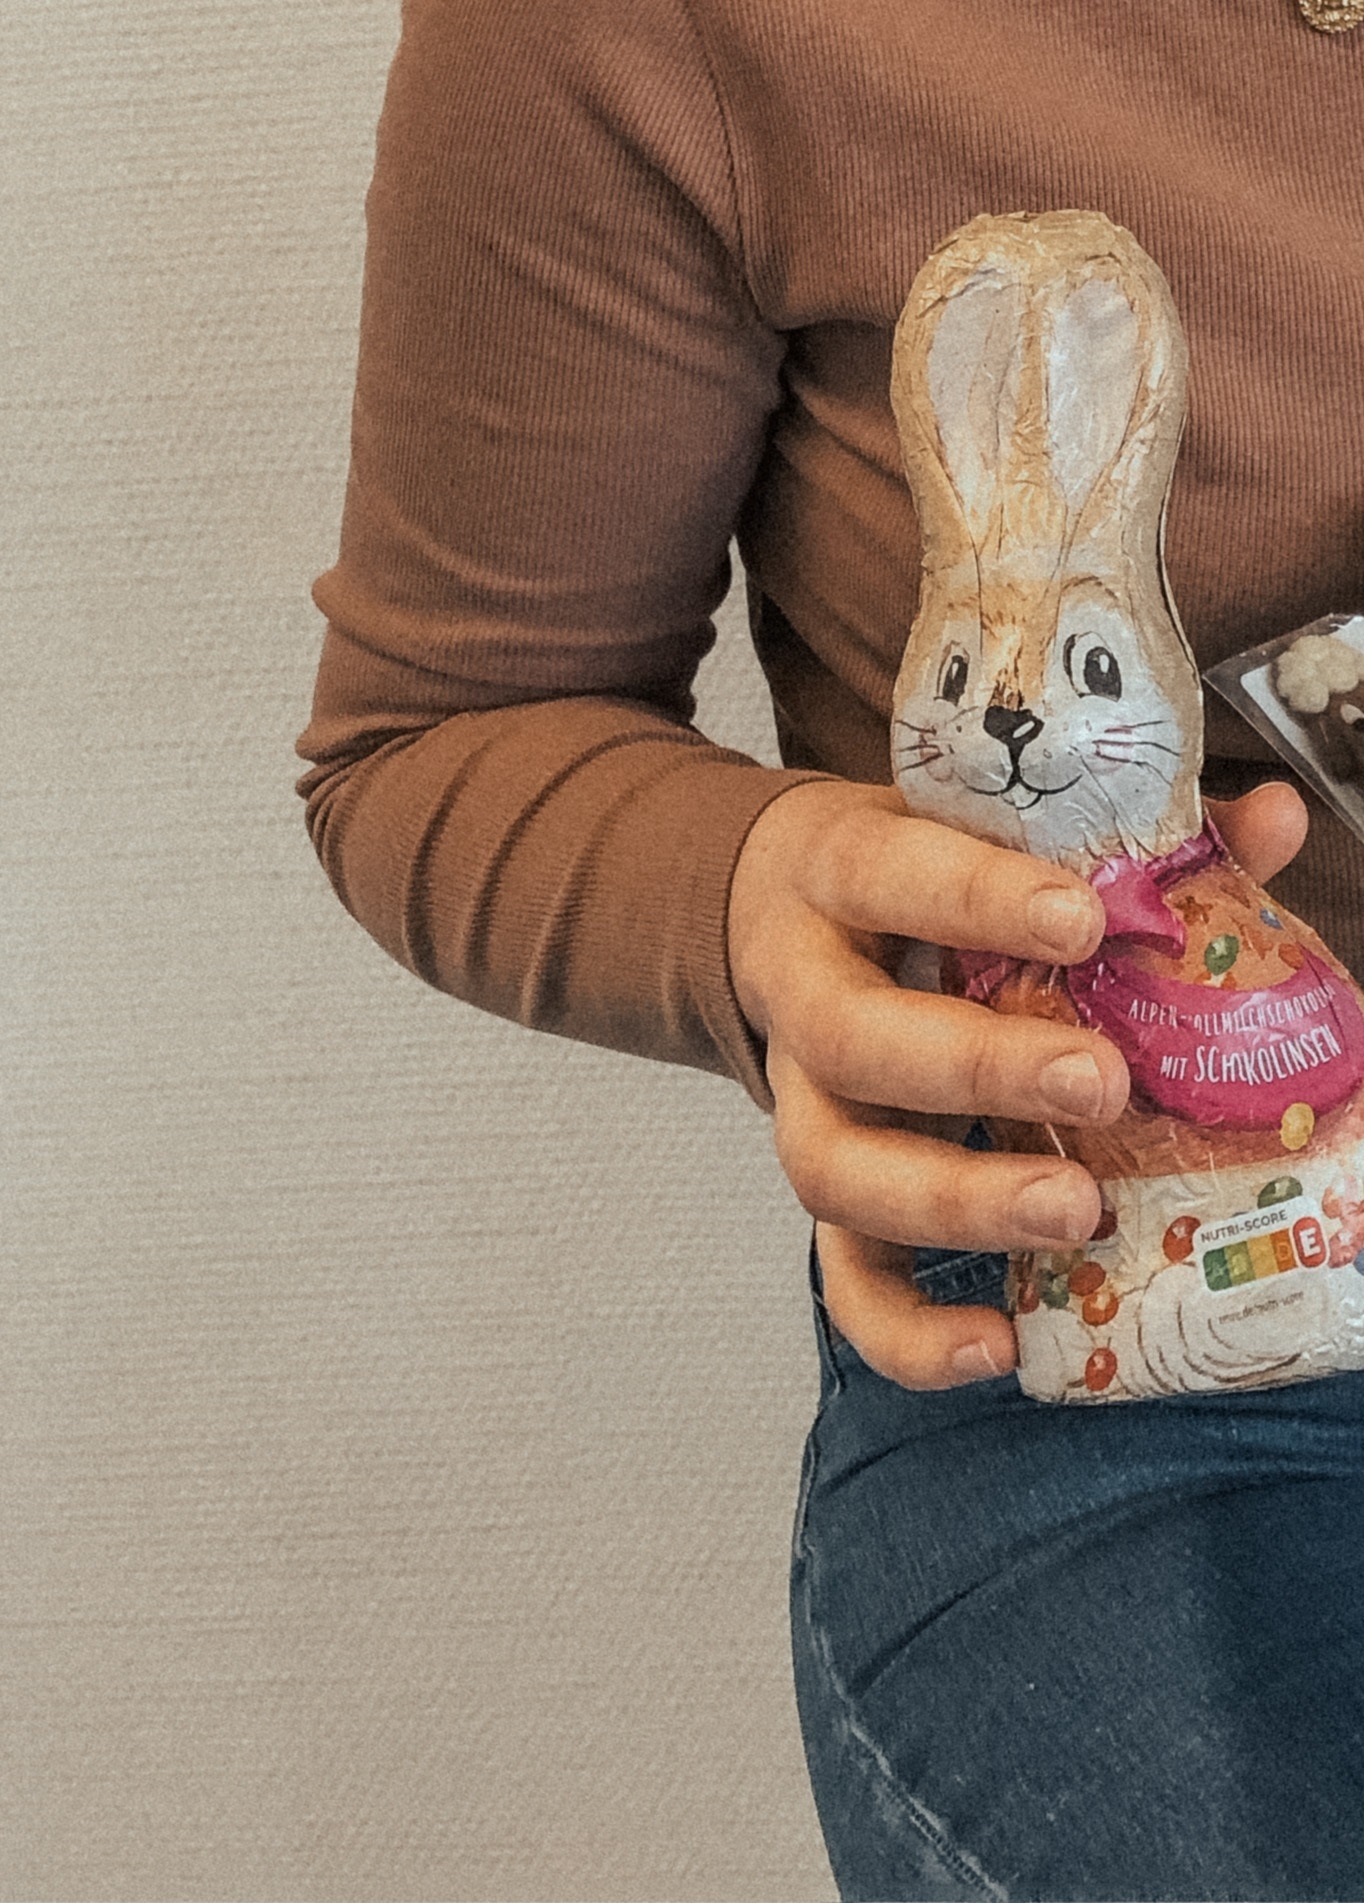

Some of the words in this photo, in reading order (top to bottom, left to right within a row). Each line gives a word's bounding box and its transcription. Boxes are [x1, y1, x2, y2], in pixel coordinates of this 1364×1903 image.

[1160, 1054, 1188, 1081] MIT
[1194, 1023, 1342, 1086] SCHOKOLINSEN
[1200, 1209, 1288, 1243] NUTRI-SCORE
[1299, 1227, 1321, 1258] E
